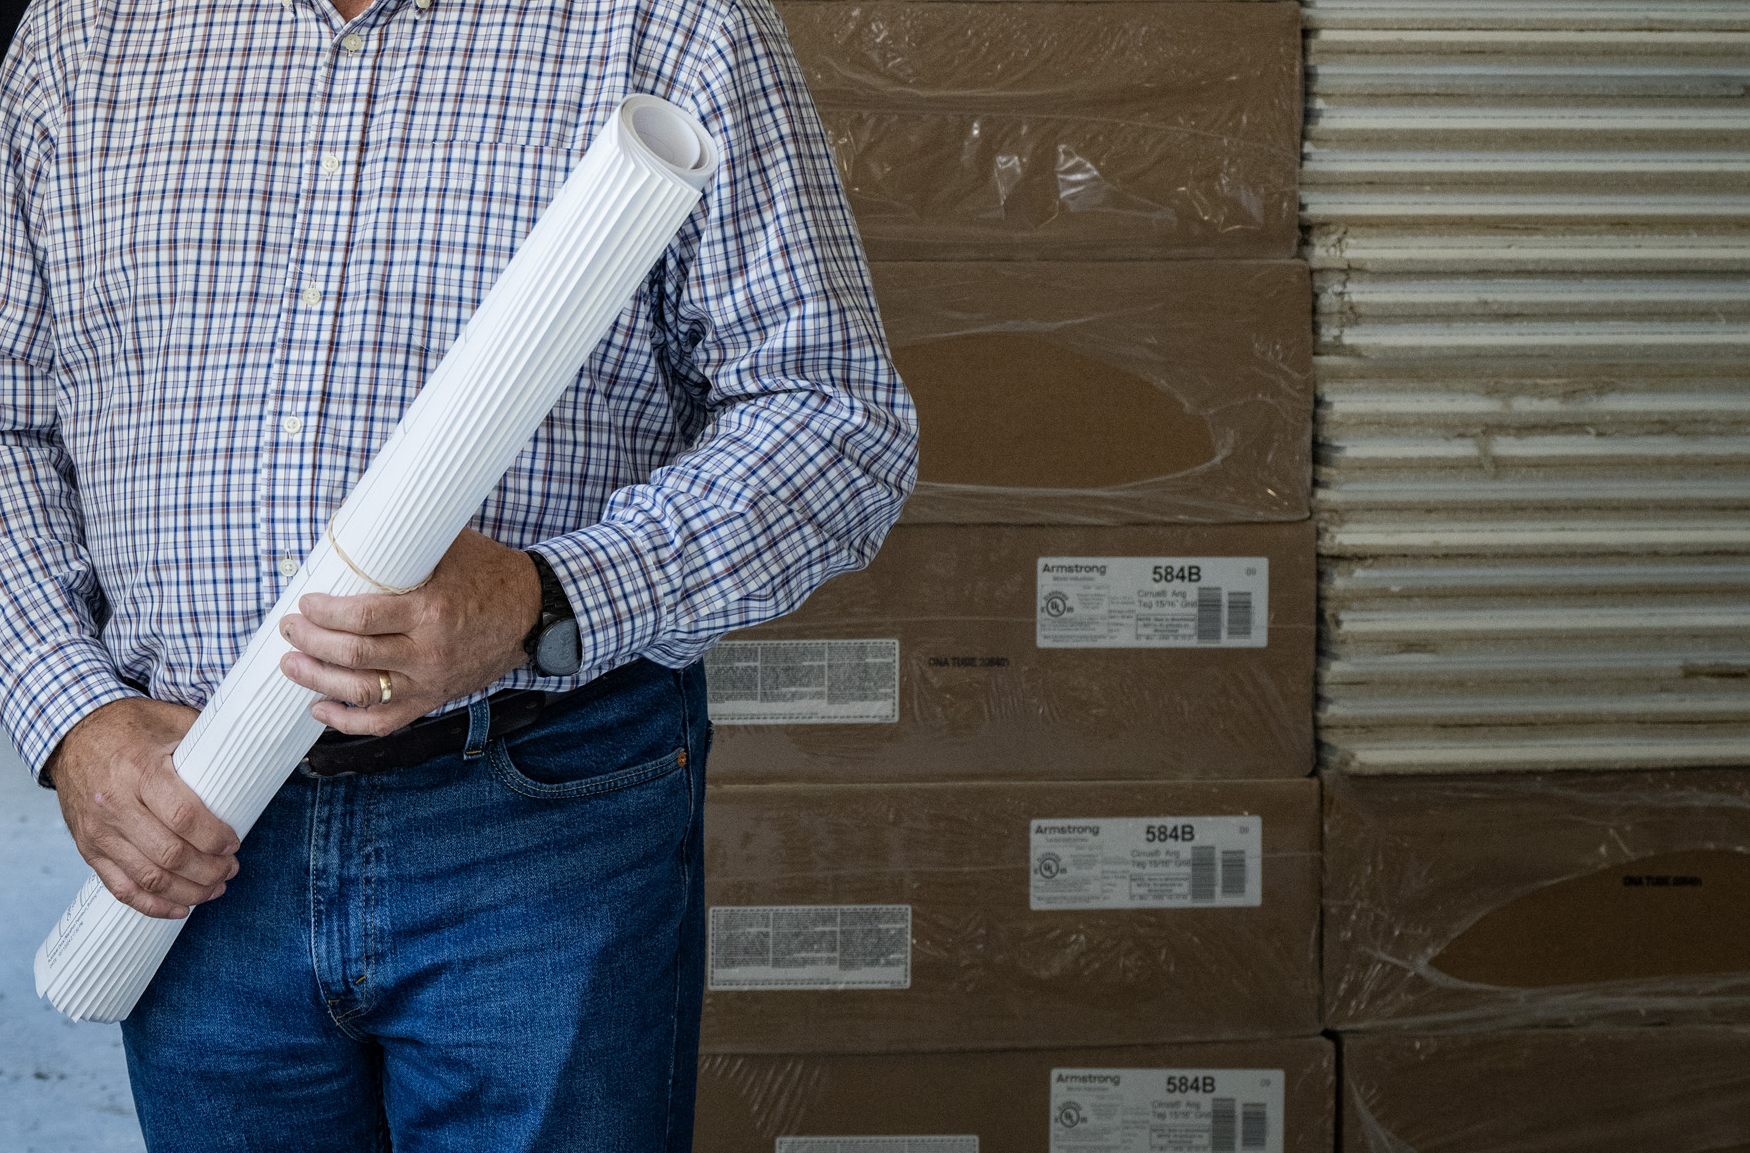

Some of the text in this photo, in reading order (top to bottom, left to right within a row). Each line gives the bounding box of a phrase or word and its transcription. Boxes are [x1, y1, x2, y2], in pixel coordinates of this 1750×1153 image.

[1042, 563, 1107, 575] Armstrong
[1152, 565, 1202, 583] 584B
[1171, 590, 1187, 599] Ang
[1035, 824, 1100, 837] Armstrong
[1146, 825, 1195, 843] 584B
[1056, 1073, 1120, 1086] Armstrong
[1166, 1076, 1216, 1094] 584B
